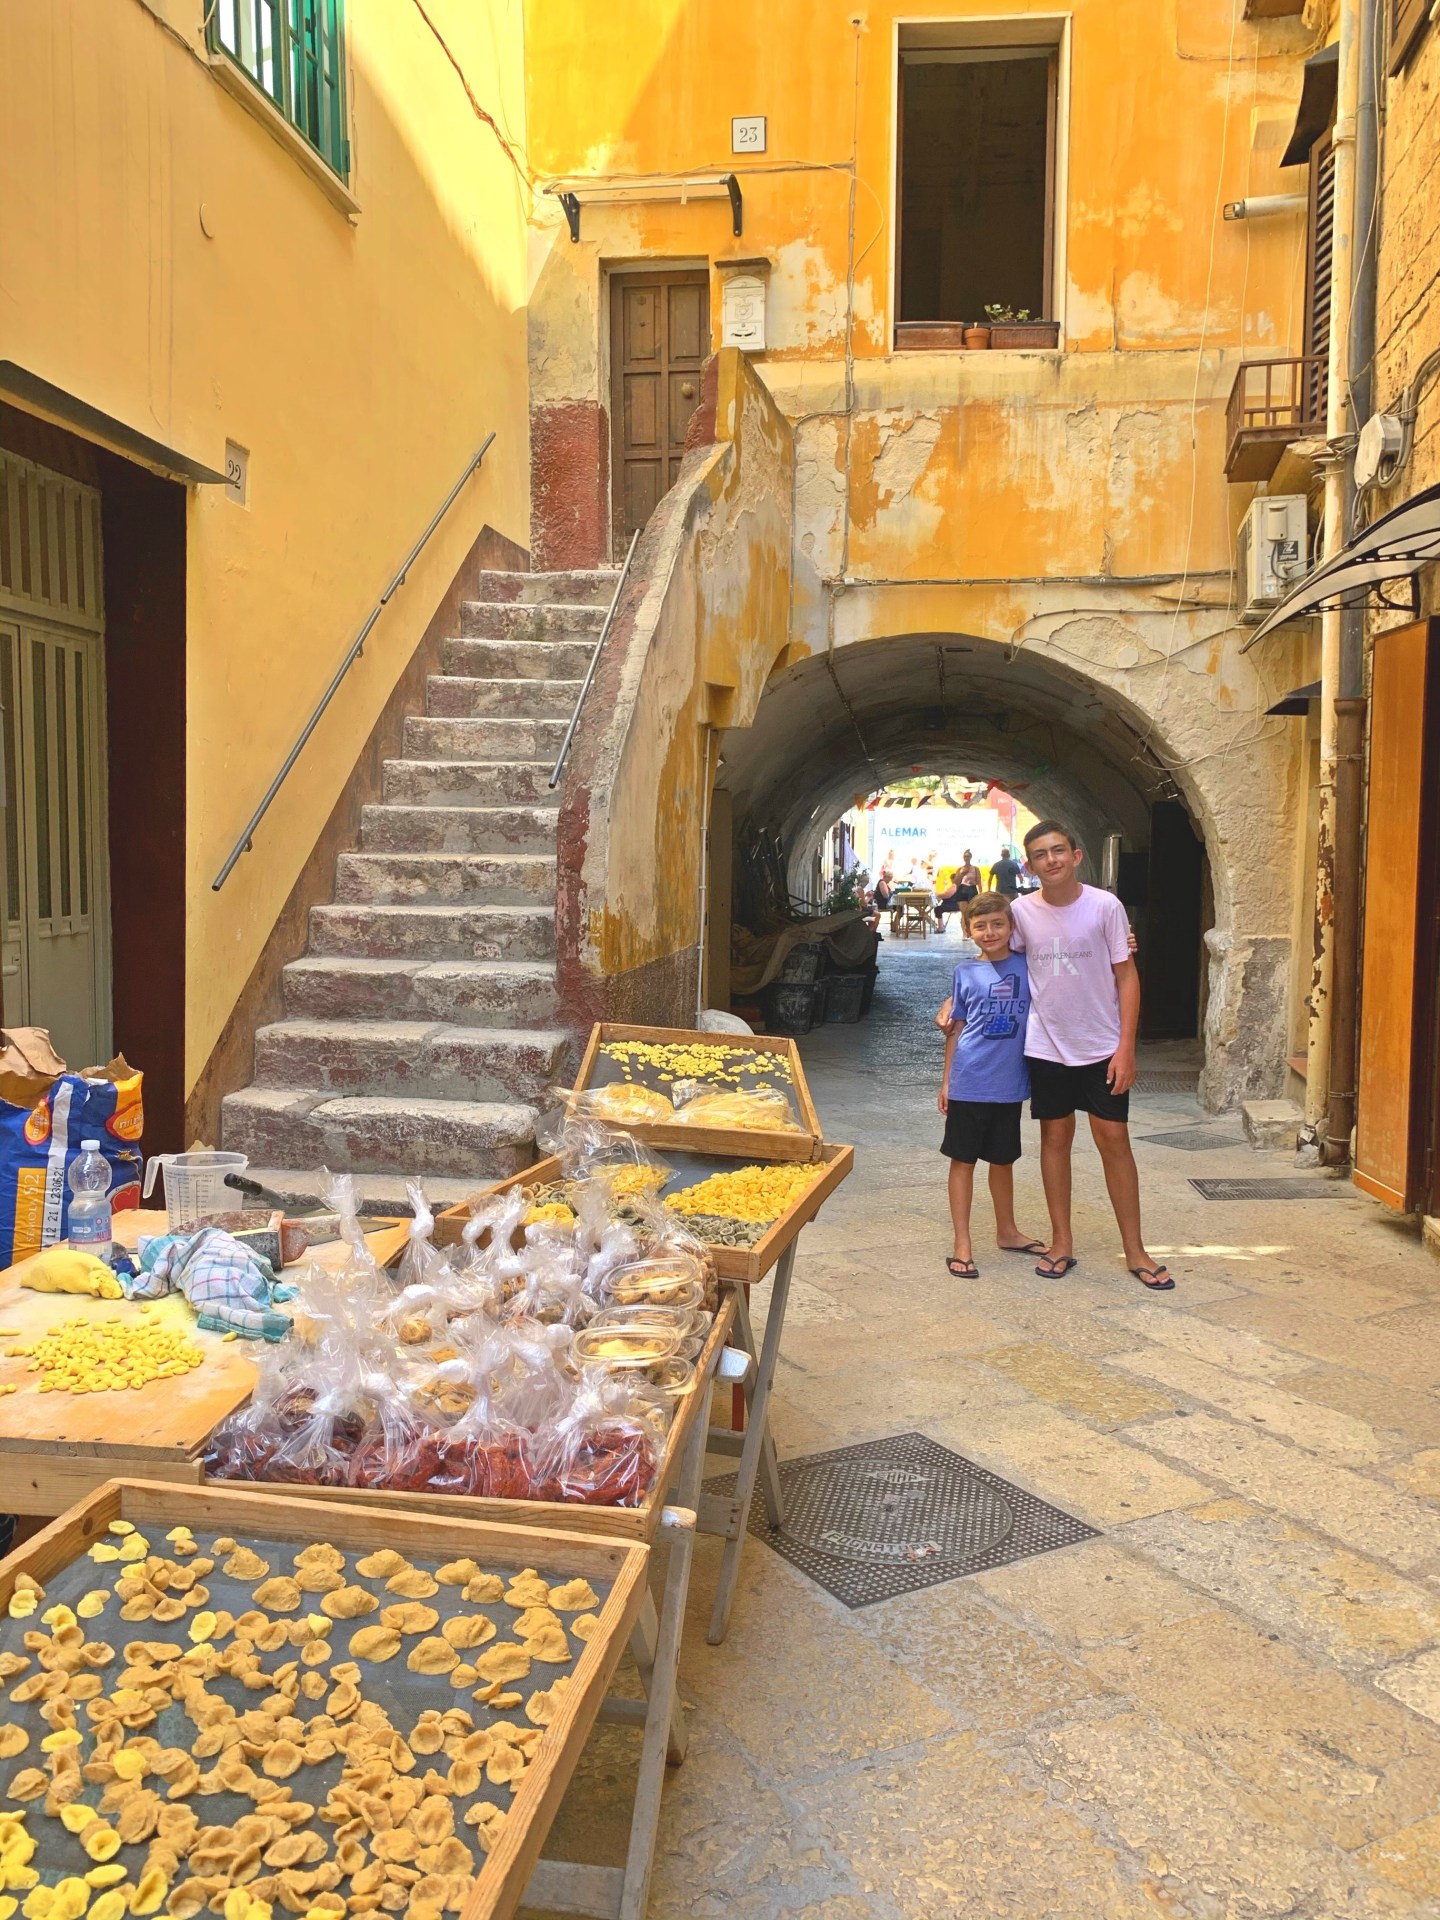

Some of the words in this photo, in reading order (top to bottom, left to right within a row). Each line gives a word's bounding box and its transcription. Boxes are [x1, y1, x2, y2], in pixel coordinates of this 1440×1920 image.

[739, 126, 758, 143] 23
[228, 459, 242, 490] 22
[880, 826, 928, 838] ALEMAR
[979, 1000, 1026, 1015] LEVI'S
[26, 1199, 38, 1242] SEMOLA
[48, 1211, 59, 1222] 21
